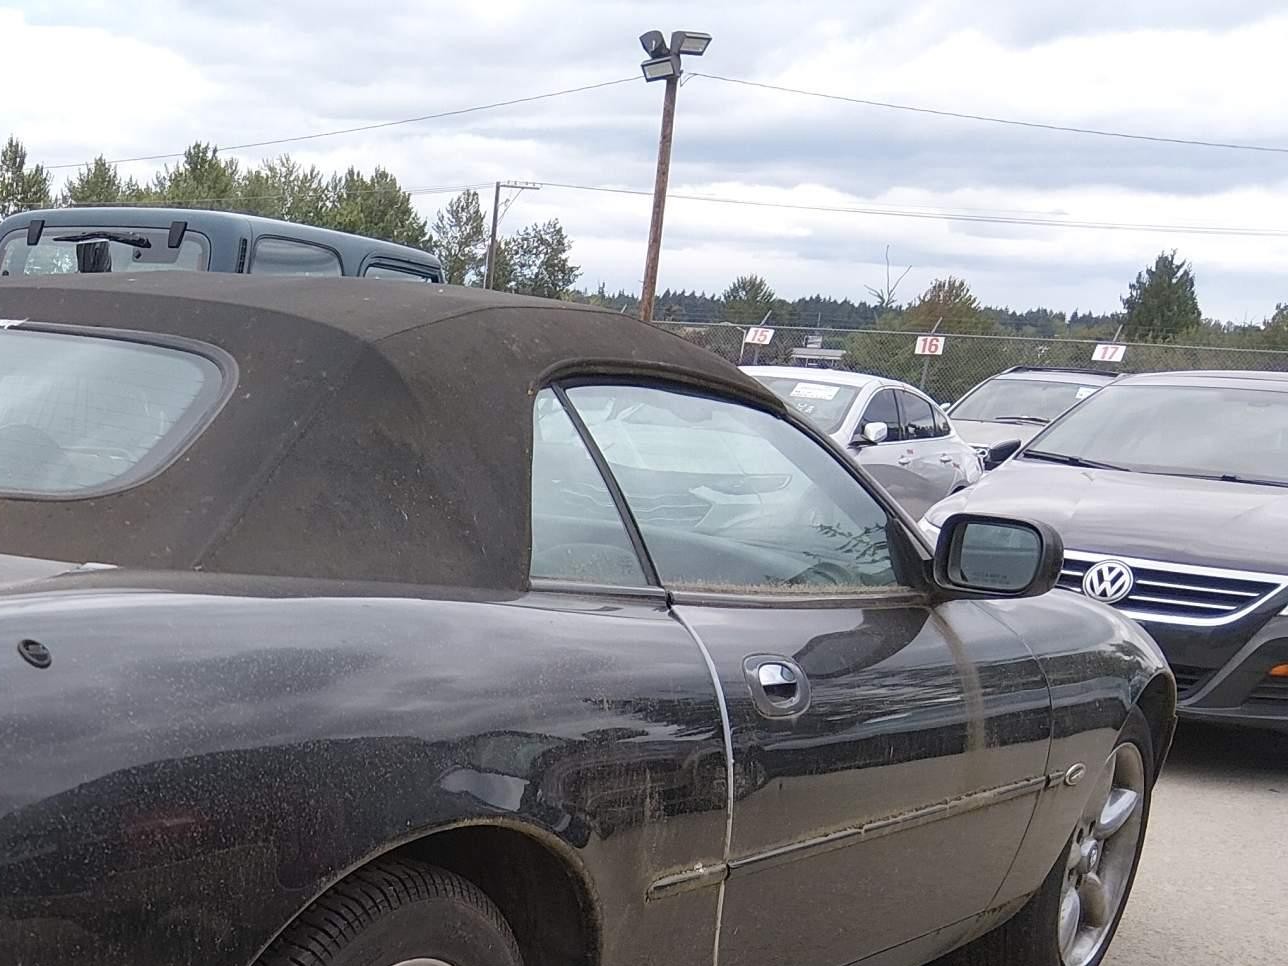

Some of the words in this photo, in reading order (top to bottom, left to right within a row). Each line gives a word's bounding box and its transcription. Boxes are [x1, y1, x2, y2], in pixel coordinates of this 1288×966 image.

[751, 329, 770, 342] 15
[921, 337, 940, 354] 16
[1100, 346, 1120, 360] 17
[1088, 562, 1129, 600] VW
